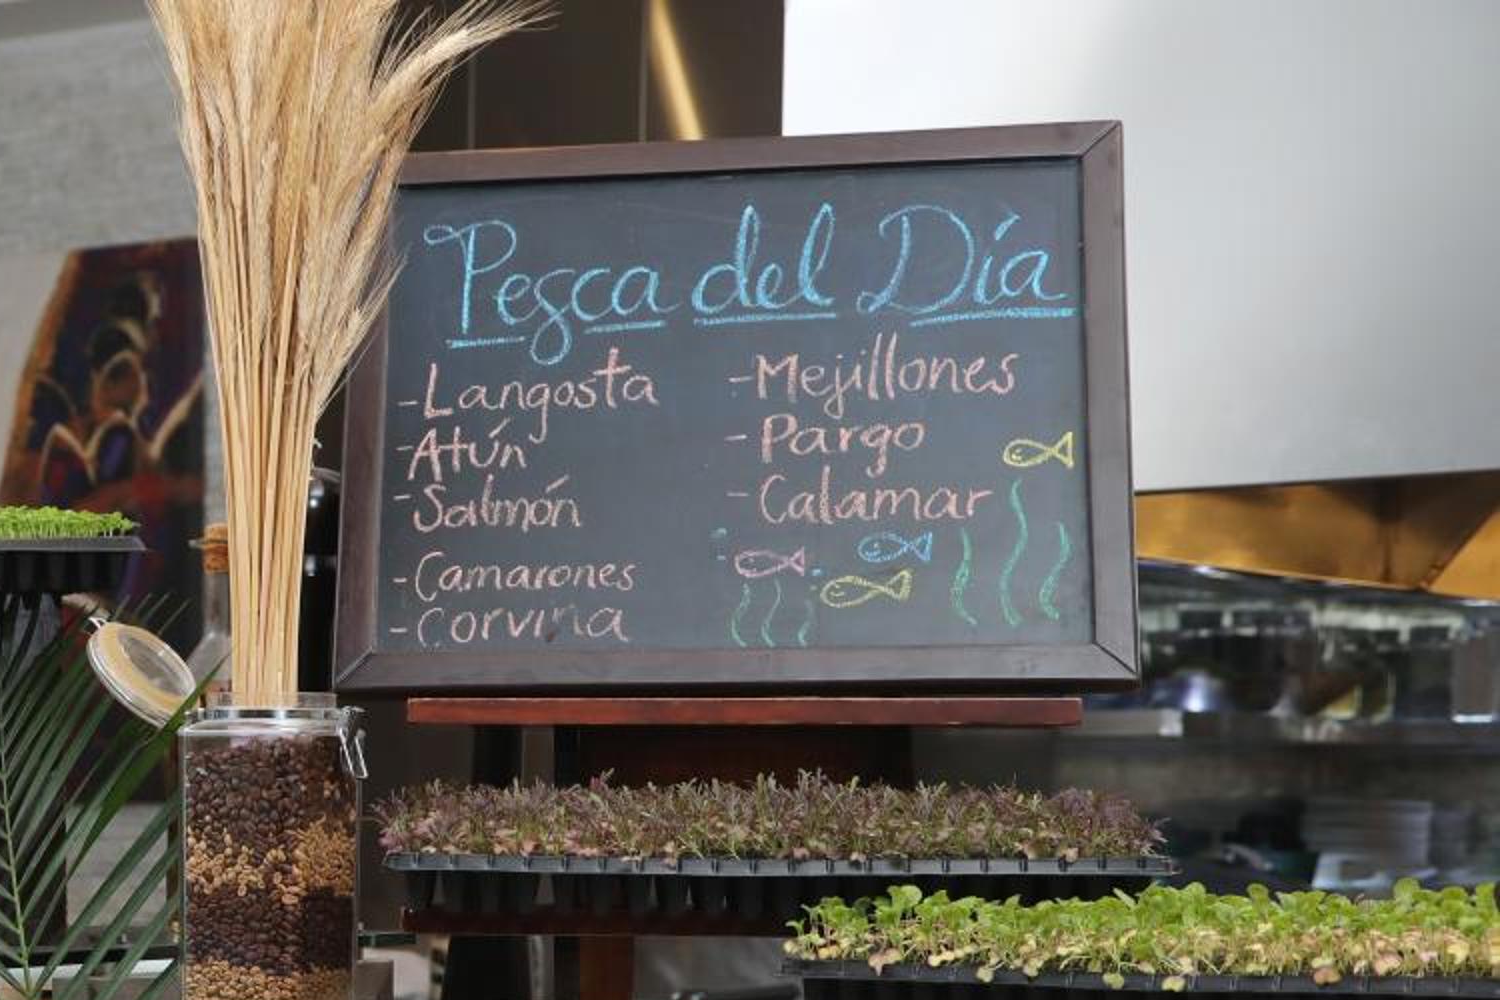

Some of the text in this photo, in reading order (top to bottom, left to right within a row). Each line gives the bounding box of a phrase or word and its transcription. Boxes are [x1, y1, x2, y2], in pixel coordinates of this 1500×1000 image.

[424, 203, 1069, 365] Pesca del Día
